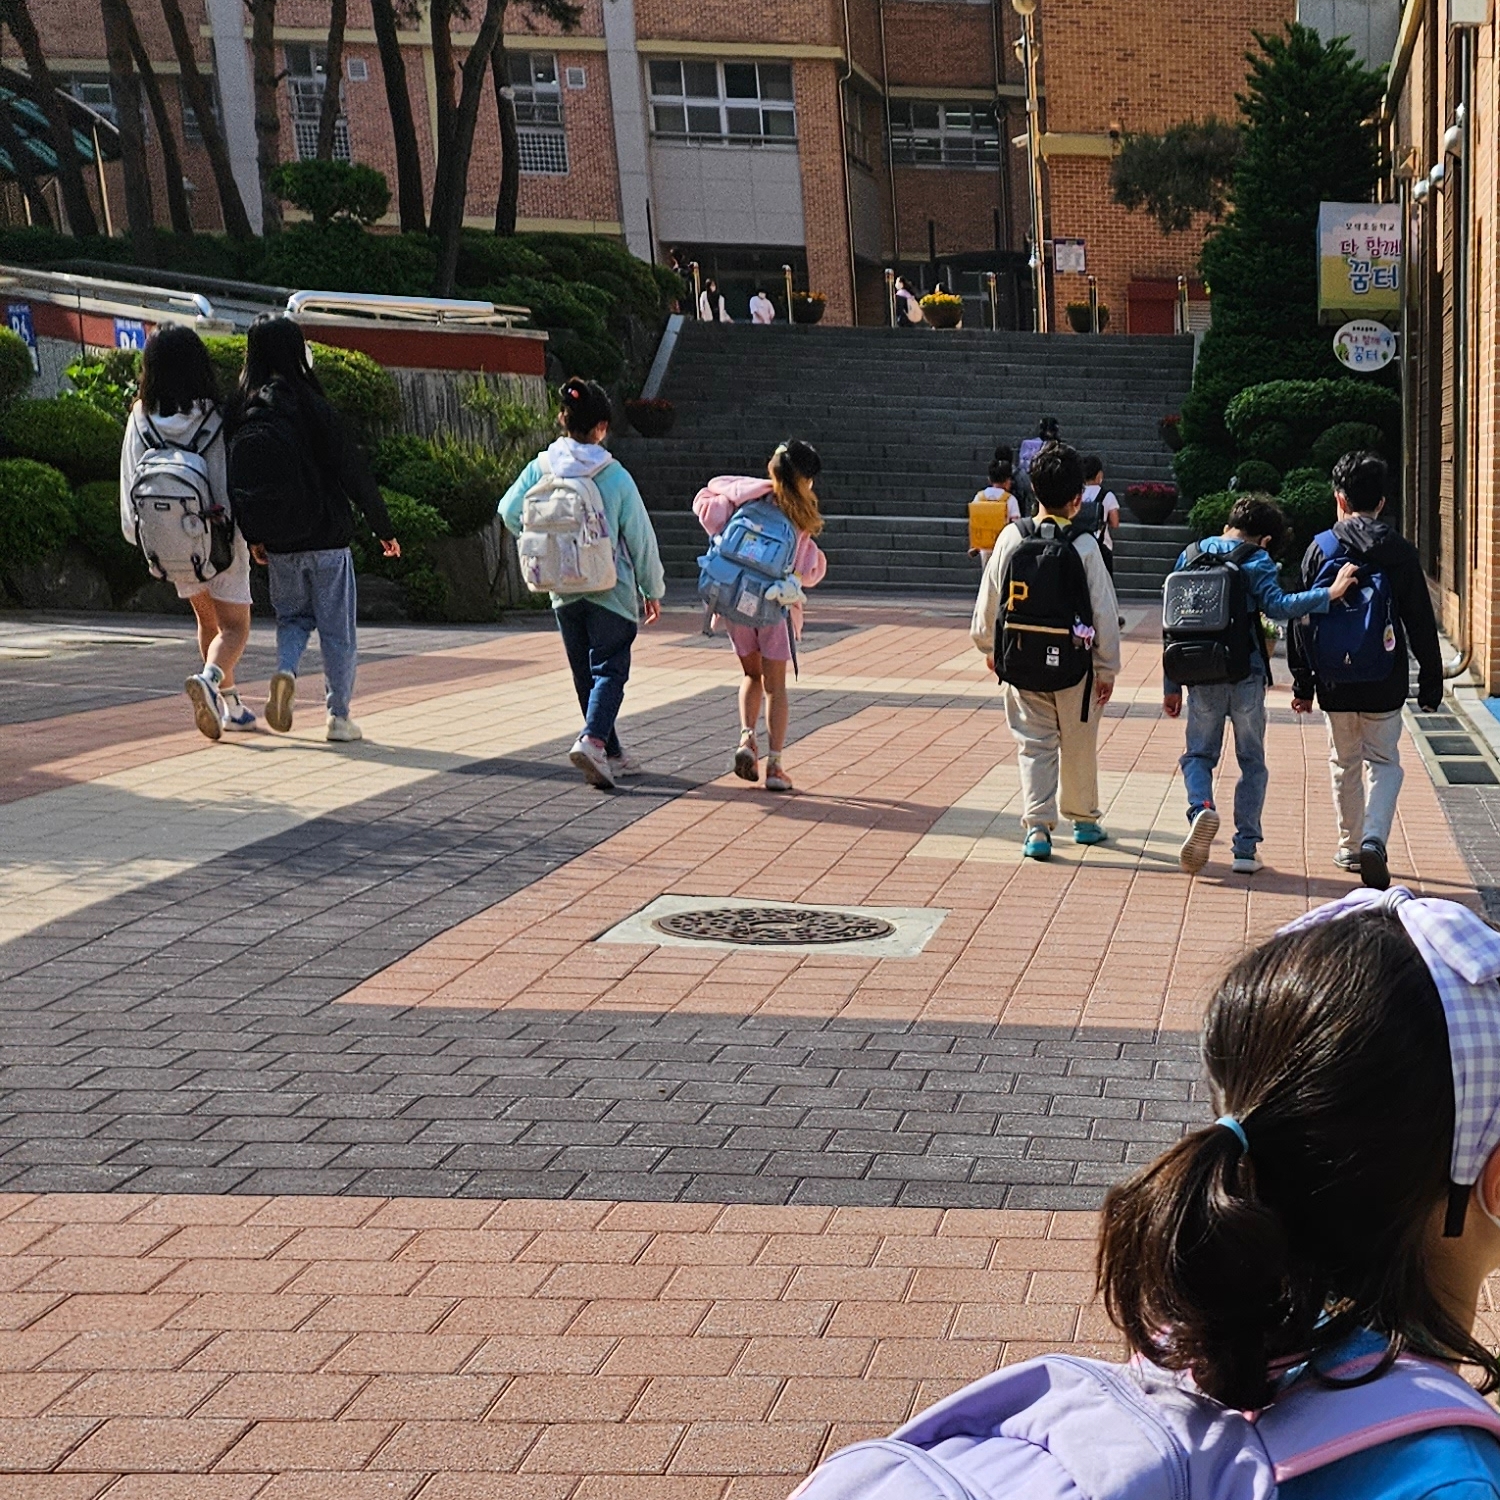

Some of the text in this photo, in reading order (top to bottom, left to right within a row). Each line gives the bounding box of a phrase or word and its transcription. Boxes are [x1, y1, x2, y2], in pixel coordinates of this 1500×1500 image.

[1340, 236, 1401, 258] 다 함께
[1349, 259, 1398, 292] 꿈터
[1007, 580, 1029, 611] P
